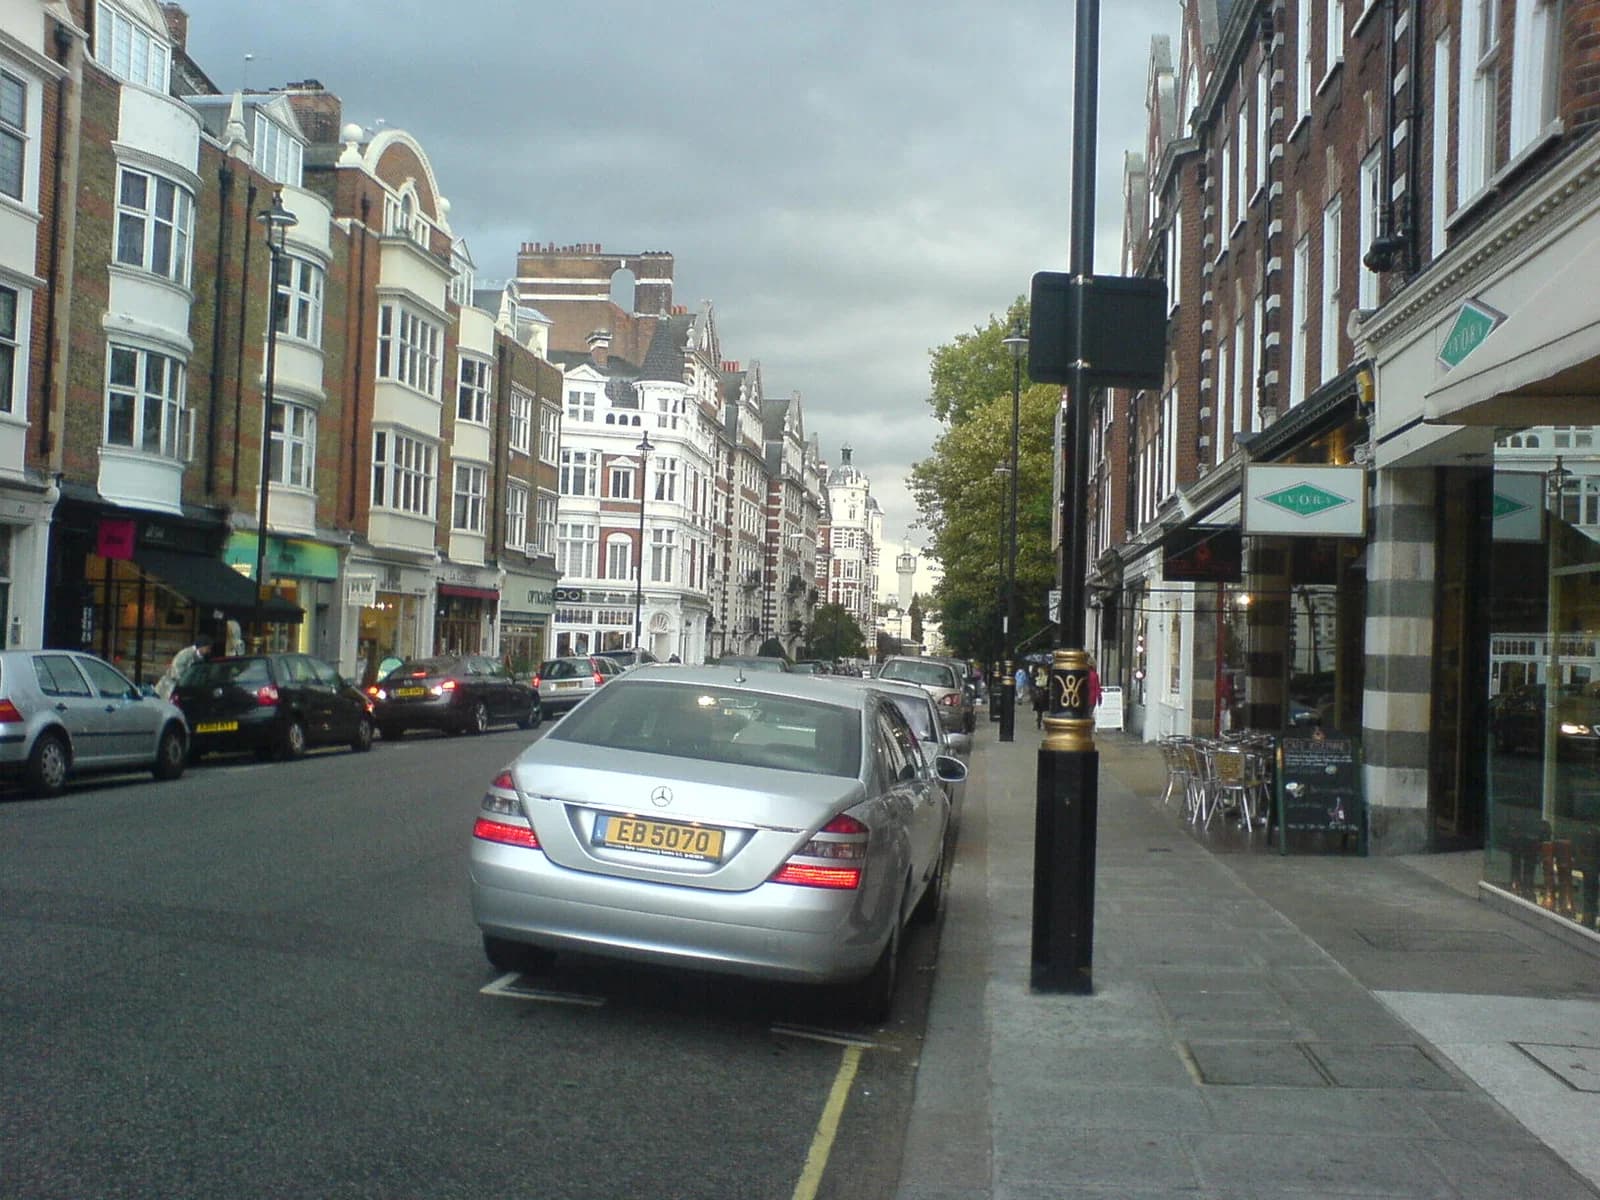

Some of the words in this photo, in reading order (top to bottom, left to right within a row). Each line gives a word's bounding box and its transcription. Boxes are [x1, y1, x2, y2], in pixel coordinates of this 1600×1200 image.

[351, 580, 372, 593] HW
[617, 820, 646, 843] EB
[650, 824, 708, 853] 5070
